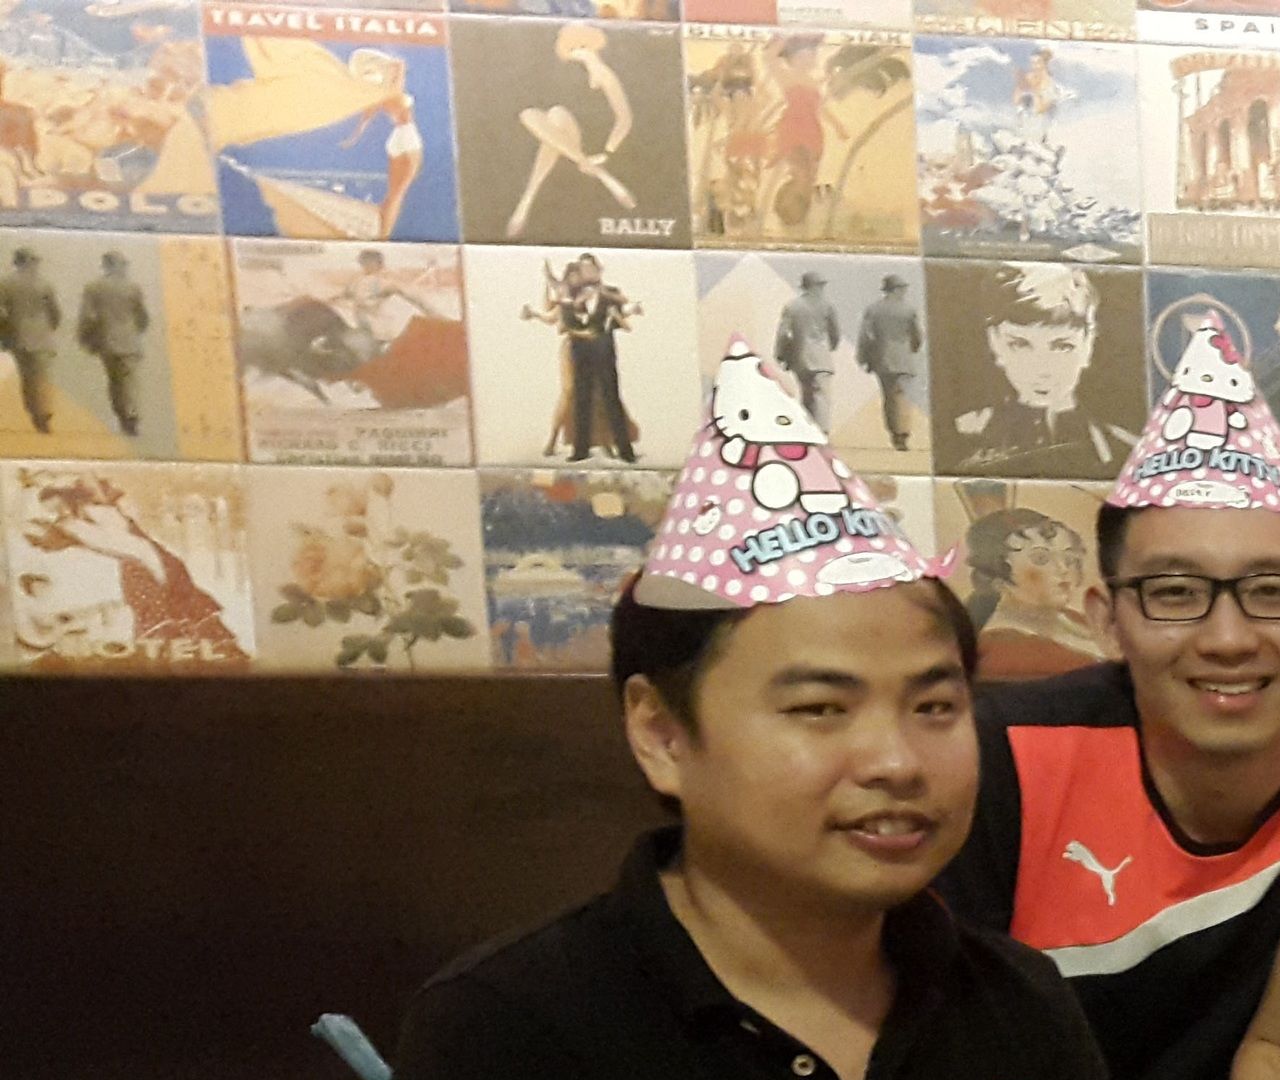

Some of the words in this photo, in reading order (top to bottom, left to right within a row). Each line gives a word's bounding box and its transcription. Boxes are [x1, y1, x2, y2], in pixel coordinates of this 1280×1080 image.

[211, 9, 322, 31] TRAVEL
[335, 15, 438, 37] ITALIA
[599, 216, 676, 237] BALLY
[1131, 446, 1205, 485] HELLO
[730, 511, 840, 574] HELLO
